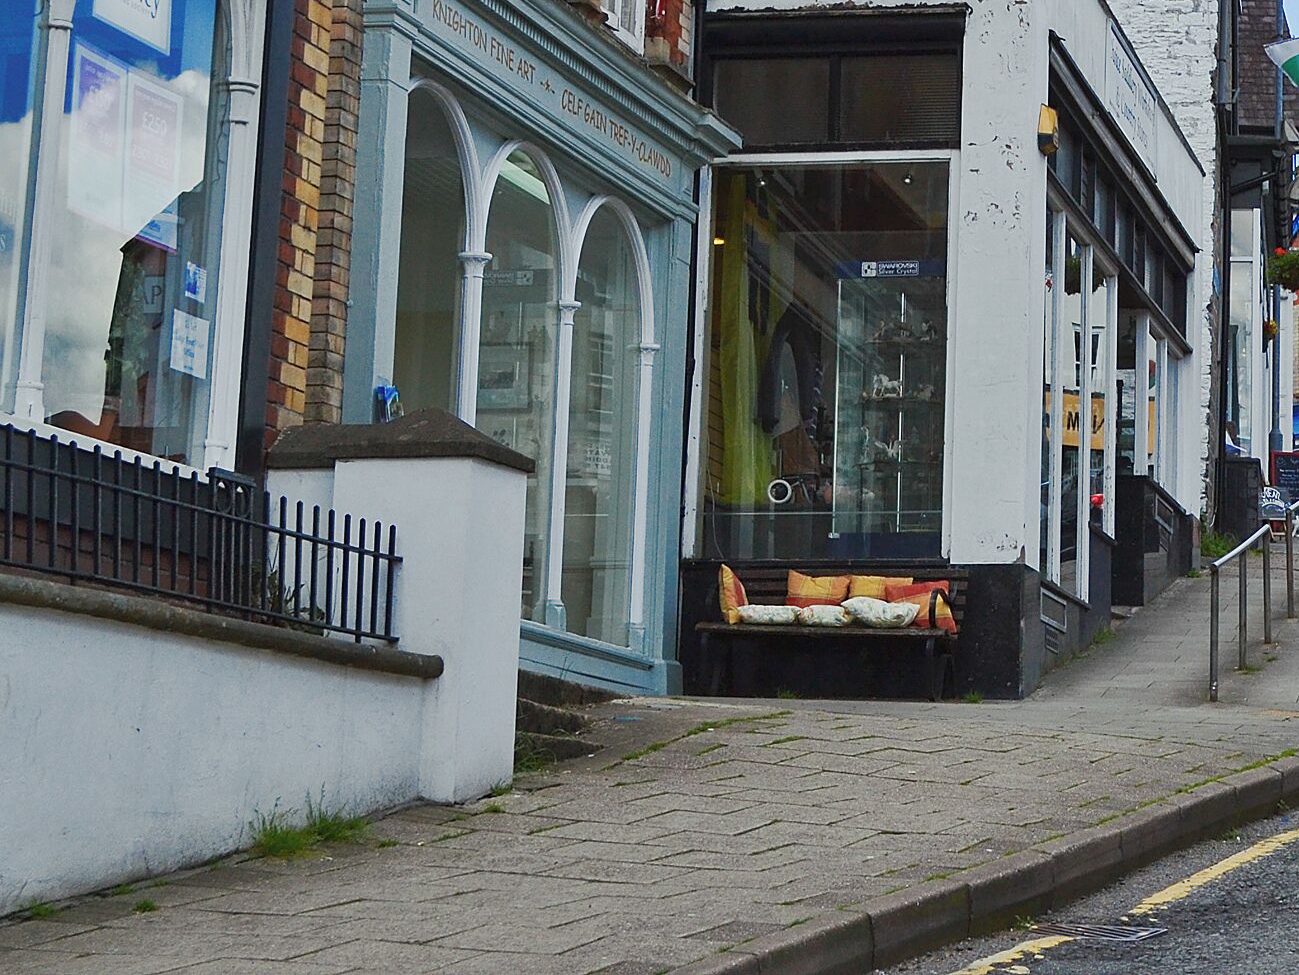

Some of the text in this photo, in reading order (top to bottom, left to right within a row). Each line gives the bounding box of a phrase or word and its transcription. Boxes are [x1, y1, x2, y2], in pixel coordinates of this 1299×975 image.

[490, 37, 514, 71] FINE
[517, 58, 536, 84] ART
[562, 89, 583, 116] CELF
[584, 103, 607, 135] GAIN
[609, 119, 671, 178] TREF-Y-CLAWDD
[896, 267, 918, 277] Crystal
